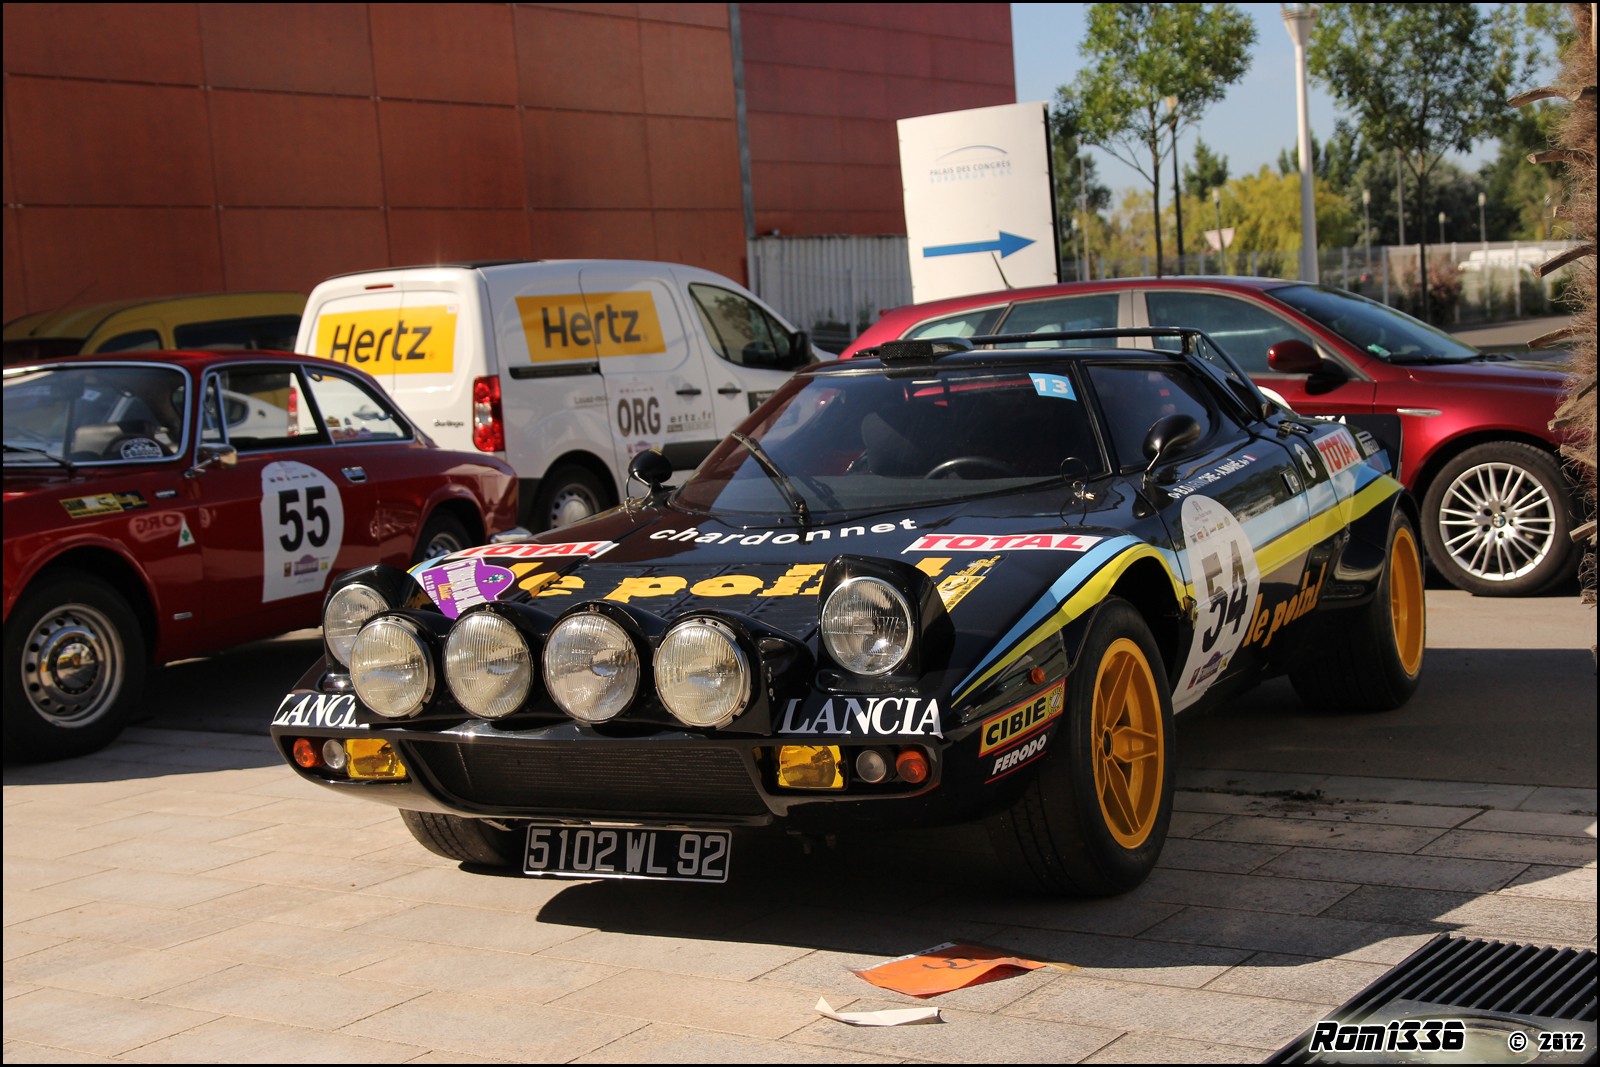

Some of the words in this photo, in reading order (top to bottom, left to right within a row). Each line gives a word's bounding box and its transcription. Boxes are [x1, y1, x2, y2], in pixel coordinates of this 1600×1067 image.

[929, 167, 955, 176] PALAIS
[956, 164, 971, 173] DES
[330, 319, 433, 363] Hertz
[541, 304, 641, 348] Hertz
[1034, 378, 1068, 394] 13
[617, 396, 661, 437] ORG
[1316, 431, 1359, 473] TOTAL
[278, 485, 330, 552] 55
[650, 518, 918, 546] chardonnet
[460, 542, 600, 557] TOTAL
[918, 535, 1085, 550] TOTAL
[1201, 539, 1249, 653] 54
[1242, 592, 1270, 648] le
[1261, 562, 1327, 648] point
[270, 693, 370, 728] LANCI
[777, 697, 943, 737] LANCIA
[991, 734, 1047, 775] FERODO
[528, 828, 618, 872] 5102
[626, 831, 667, 874] WL
[677, 833, 727, 877] 92
